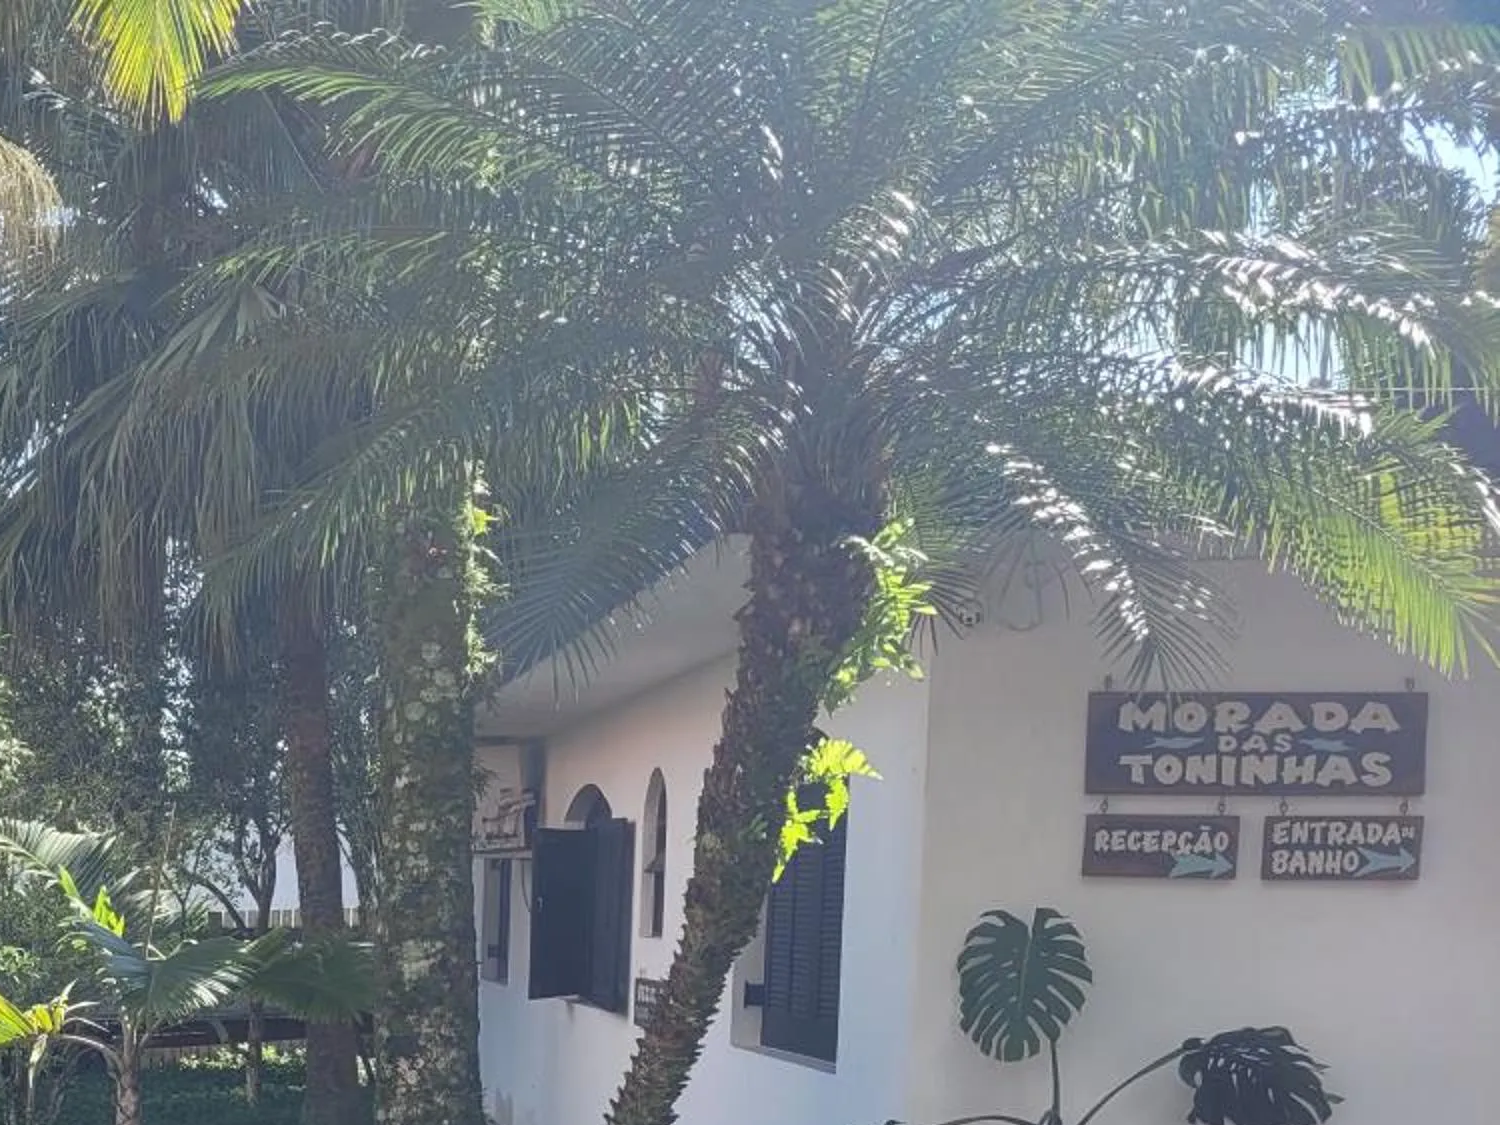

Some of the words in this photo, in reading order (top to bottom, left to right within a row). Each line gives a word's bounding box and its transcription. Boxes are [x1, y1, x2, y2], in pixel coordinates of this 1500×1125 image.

[1118, 700, 1400, 734] MORADA
[1217, 734, 1293, 752] DAS
[1119, 752, 1392, 787] TONINHAS
[1094, 824, 1230, 856] RECEPÇÃO
[1271, 820, 1402, 846] ENTRADA
[1271, 849, 1360, 875] BANHO
